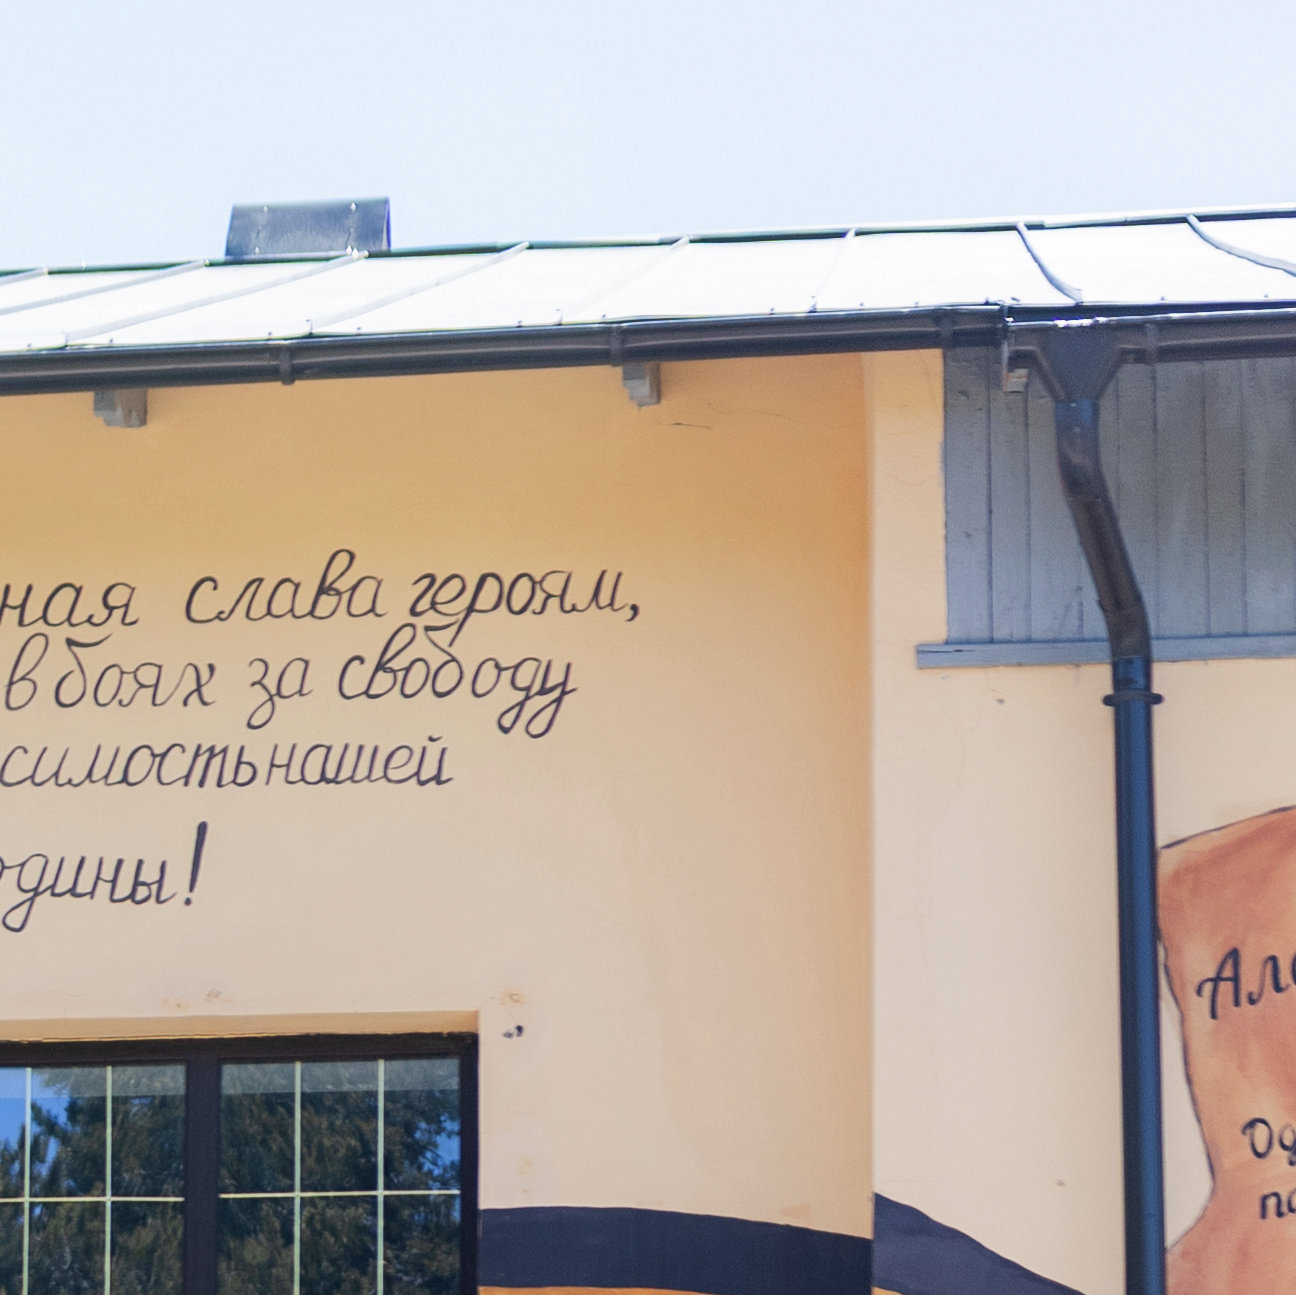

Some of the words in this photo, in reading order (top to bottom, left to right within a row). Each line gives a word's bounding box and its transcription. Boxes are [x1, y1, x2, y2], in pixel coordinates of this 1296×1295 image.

[185, 548, 388, 625] слава
[409, 569, 640, 648] героям,
[5, 632, 50, 711] в
[54, 633, 217, 708] боях
[246, 657, 313, 730] за
[338, 622, 578, 739] свободу
[264, 734, 455, 788] нашей
[1195, 947, 1296, 1020] Ал
